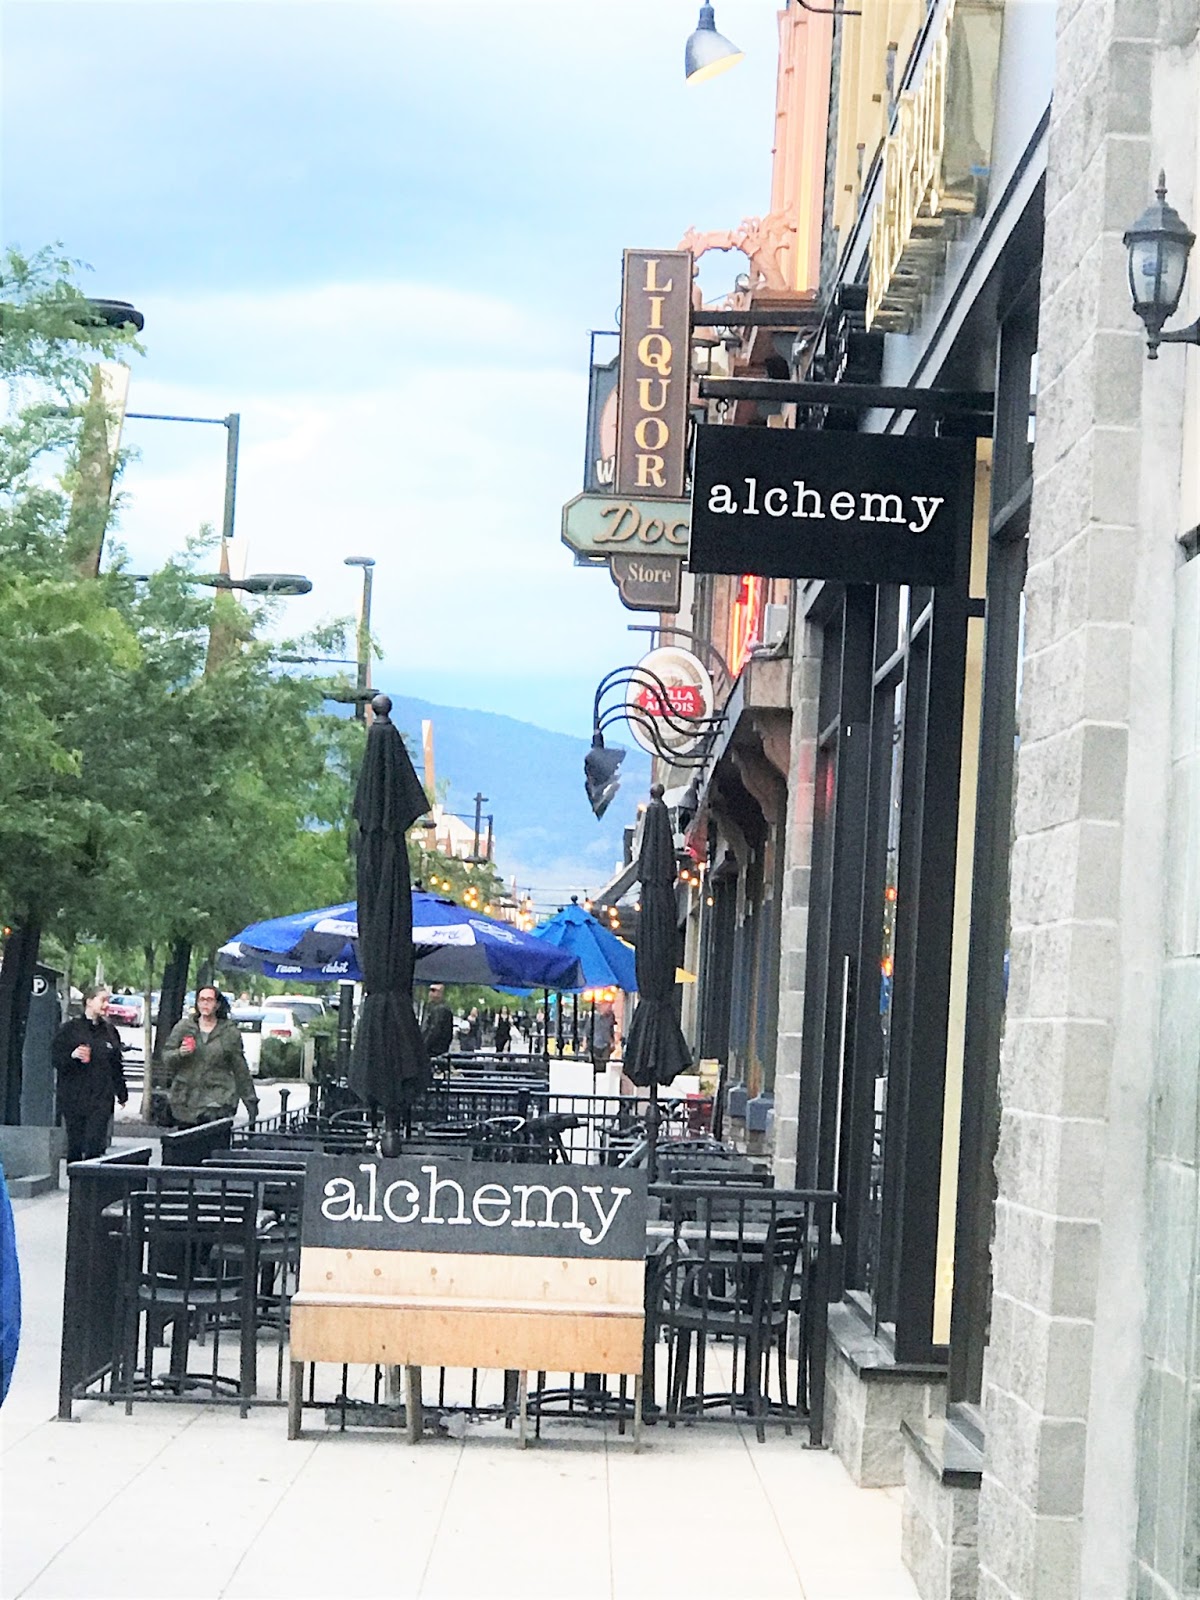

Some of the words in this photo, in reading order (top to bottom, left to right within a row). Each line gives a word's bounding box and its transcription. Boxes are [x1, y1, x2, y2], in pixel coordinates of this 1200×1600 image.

[634, 259, 673, 488] LIQUOR
[708, 478, 944, 533] alchemy
[627, 562, 672, 583] Store
[33, 978, 45, 993] P
[321, 1163, 632, 1245] alchemy
